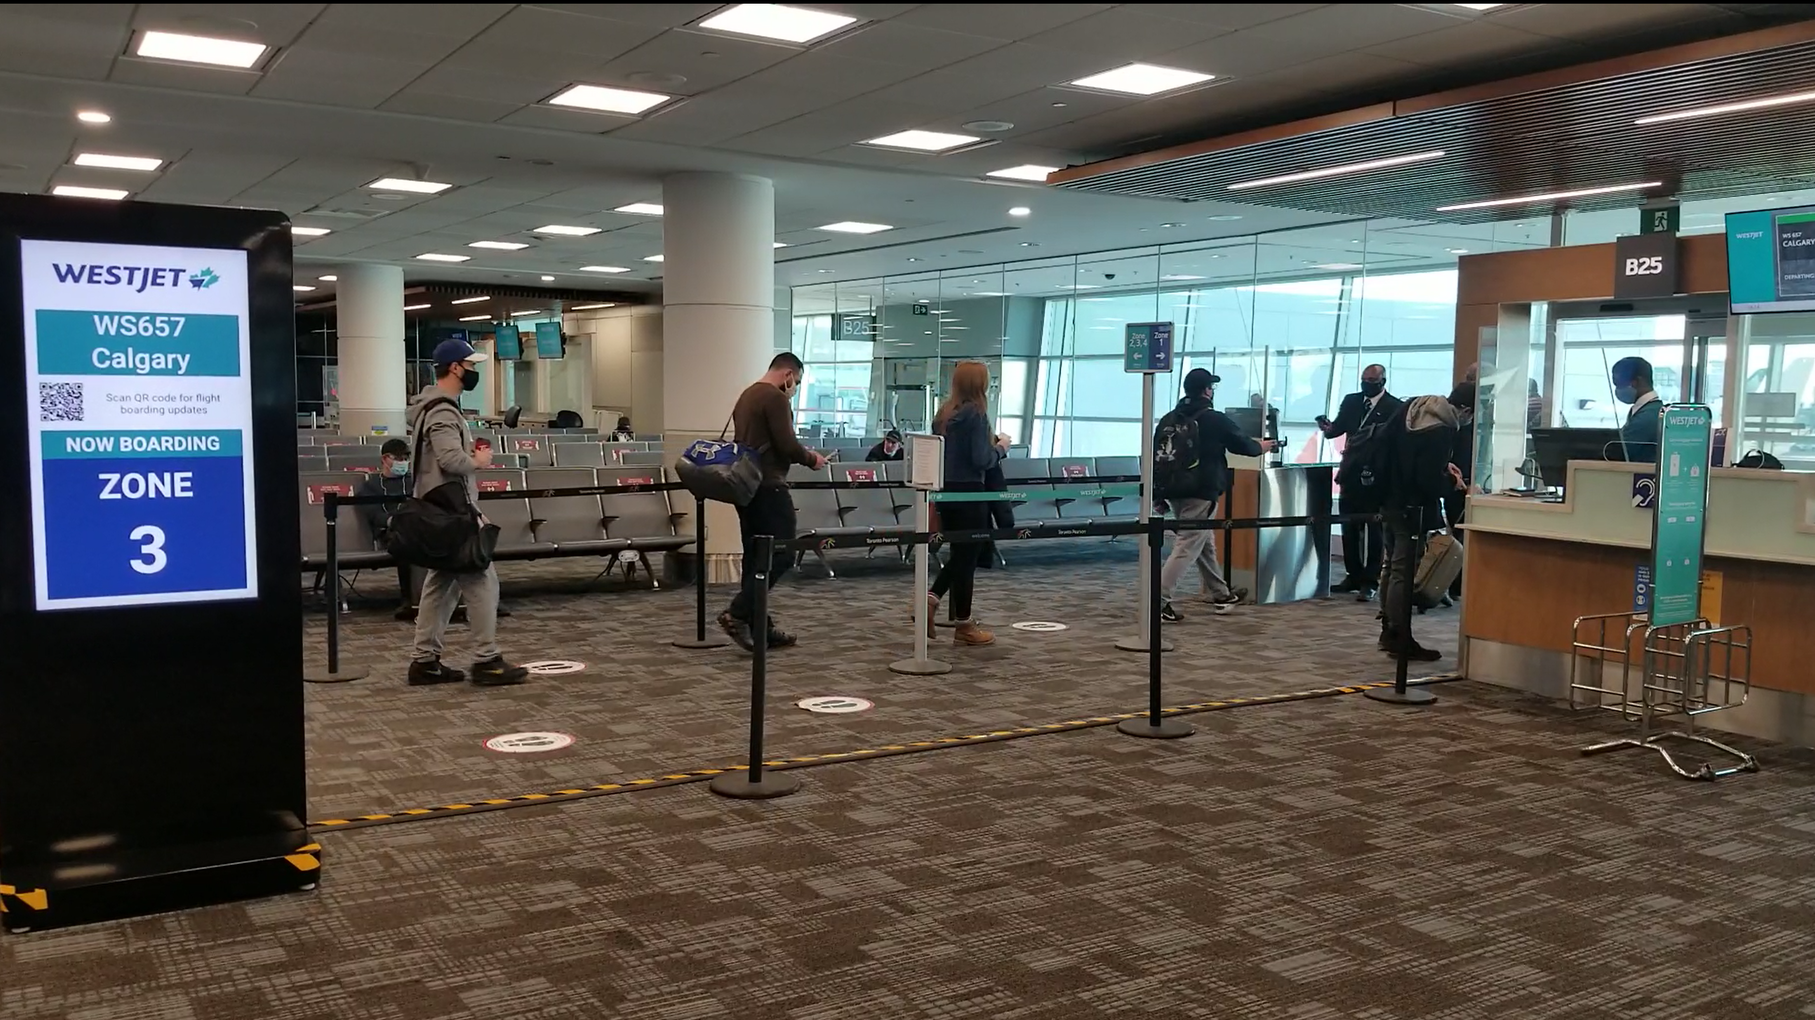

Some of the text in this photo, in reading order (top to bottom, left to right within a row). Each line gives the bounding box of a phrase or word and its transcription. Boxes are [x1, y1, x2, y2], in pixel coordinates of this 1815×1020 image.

[1624, 256, 1663, 276] B25
[52, 263, 187, 293] WESTJET
[93, 315, 187, 337] WS657
[843, 320, 870, 335] B25
[1129, 339, 1148, 348] 2,3,4
[91, 347, 191, 374] Calgary
[105, 392, 221, 405] Scan QR code for flight
[120, 405, 208, 417] boarding updates
[1669, 416, 1699, 427] WESTJET
[65, 435, 221, 453] NOW BOARDING
[98, 471, 194, 500] ZONE
[129, 525, 168, 575] 3
